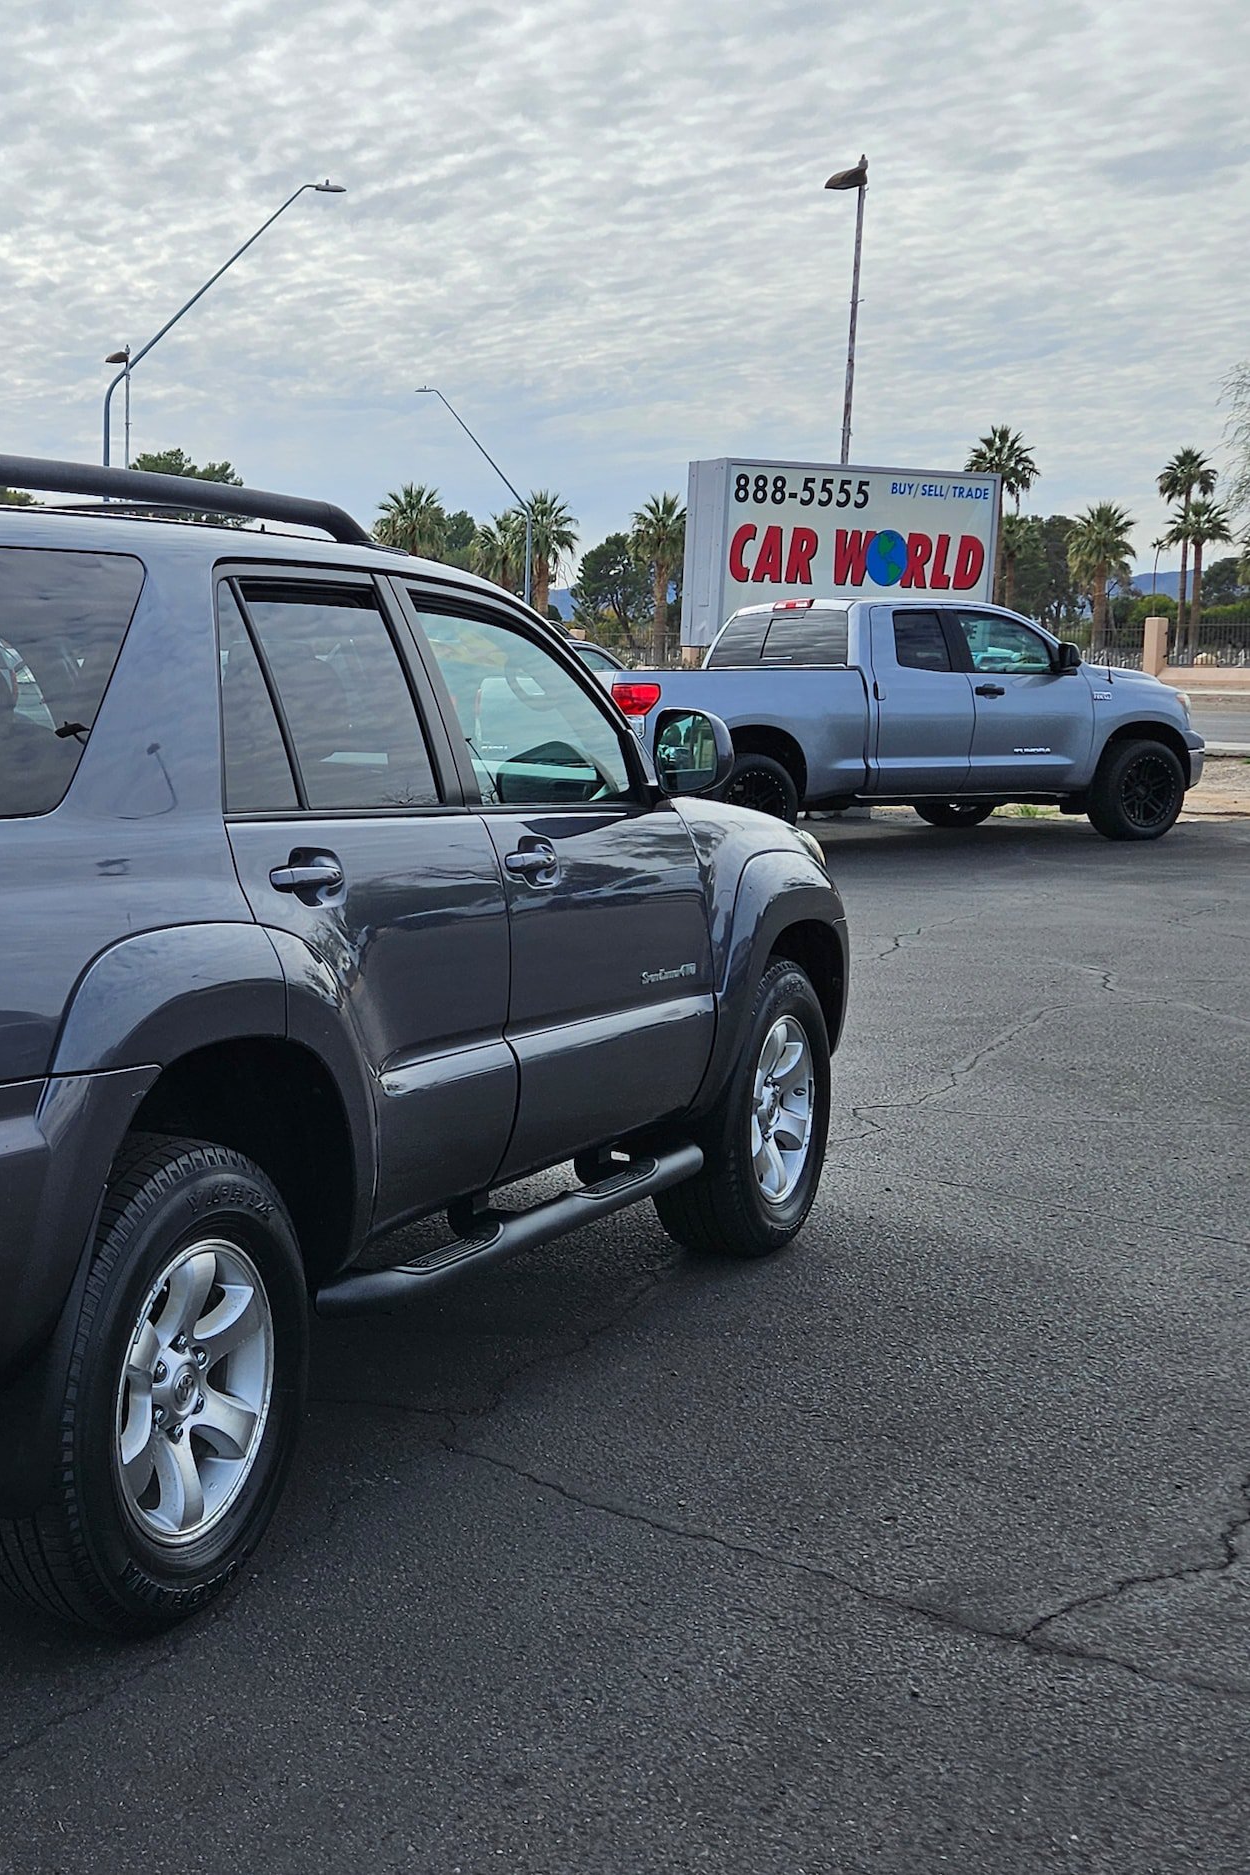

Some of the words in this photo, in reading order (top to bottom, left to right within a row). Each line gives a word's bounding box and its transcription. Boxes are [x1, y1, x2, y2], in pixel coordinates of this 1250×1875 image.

[734, 473, 870, 509] 888-5555
[952, 486, 989, 500] TRADE
[729, 523, 819, 585] CAR
